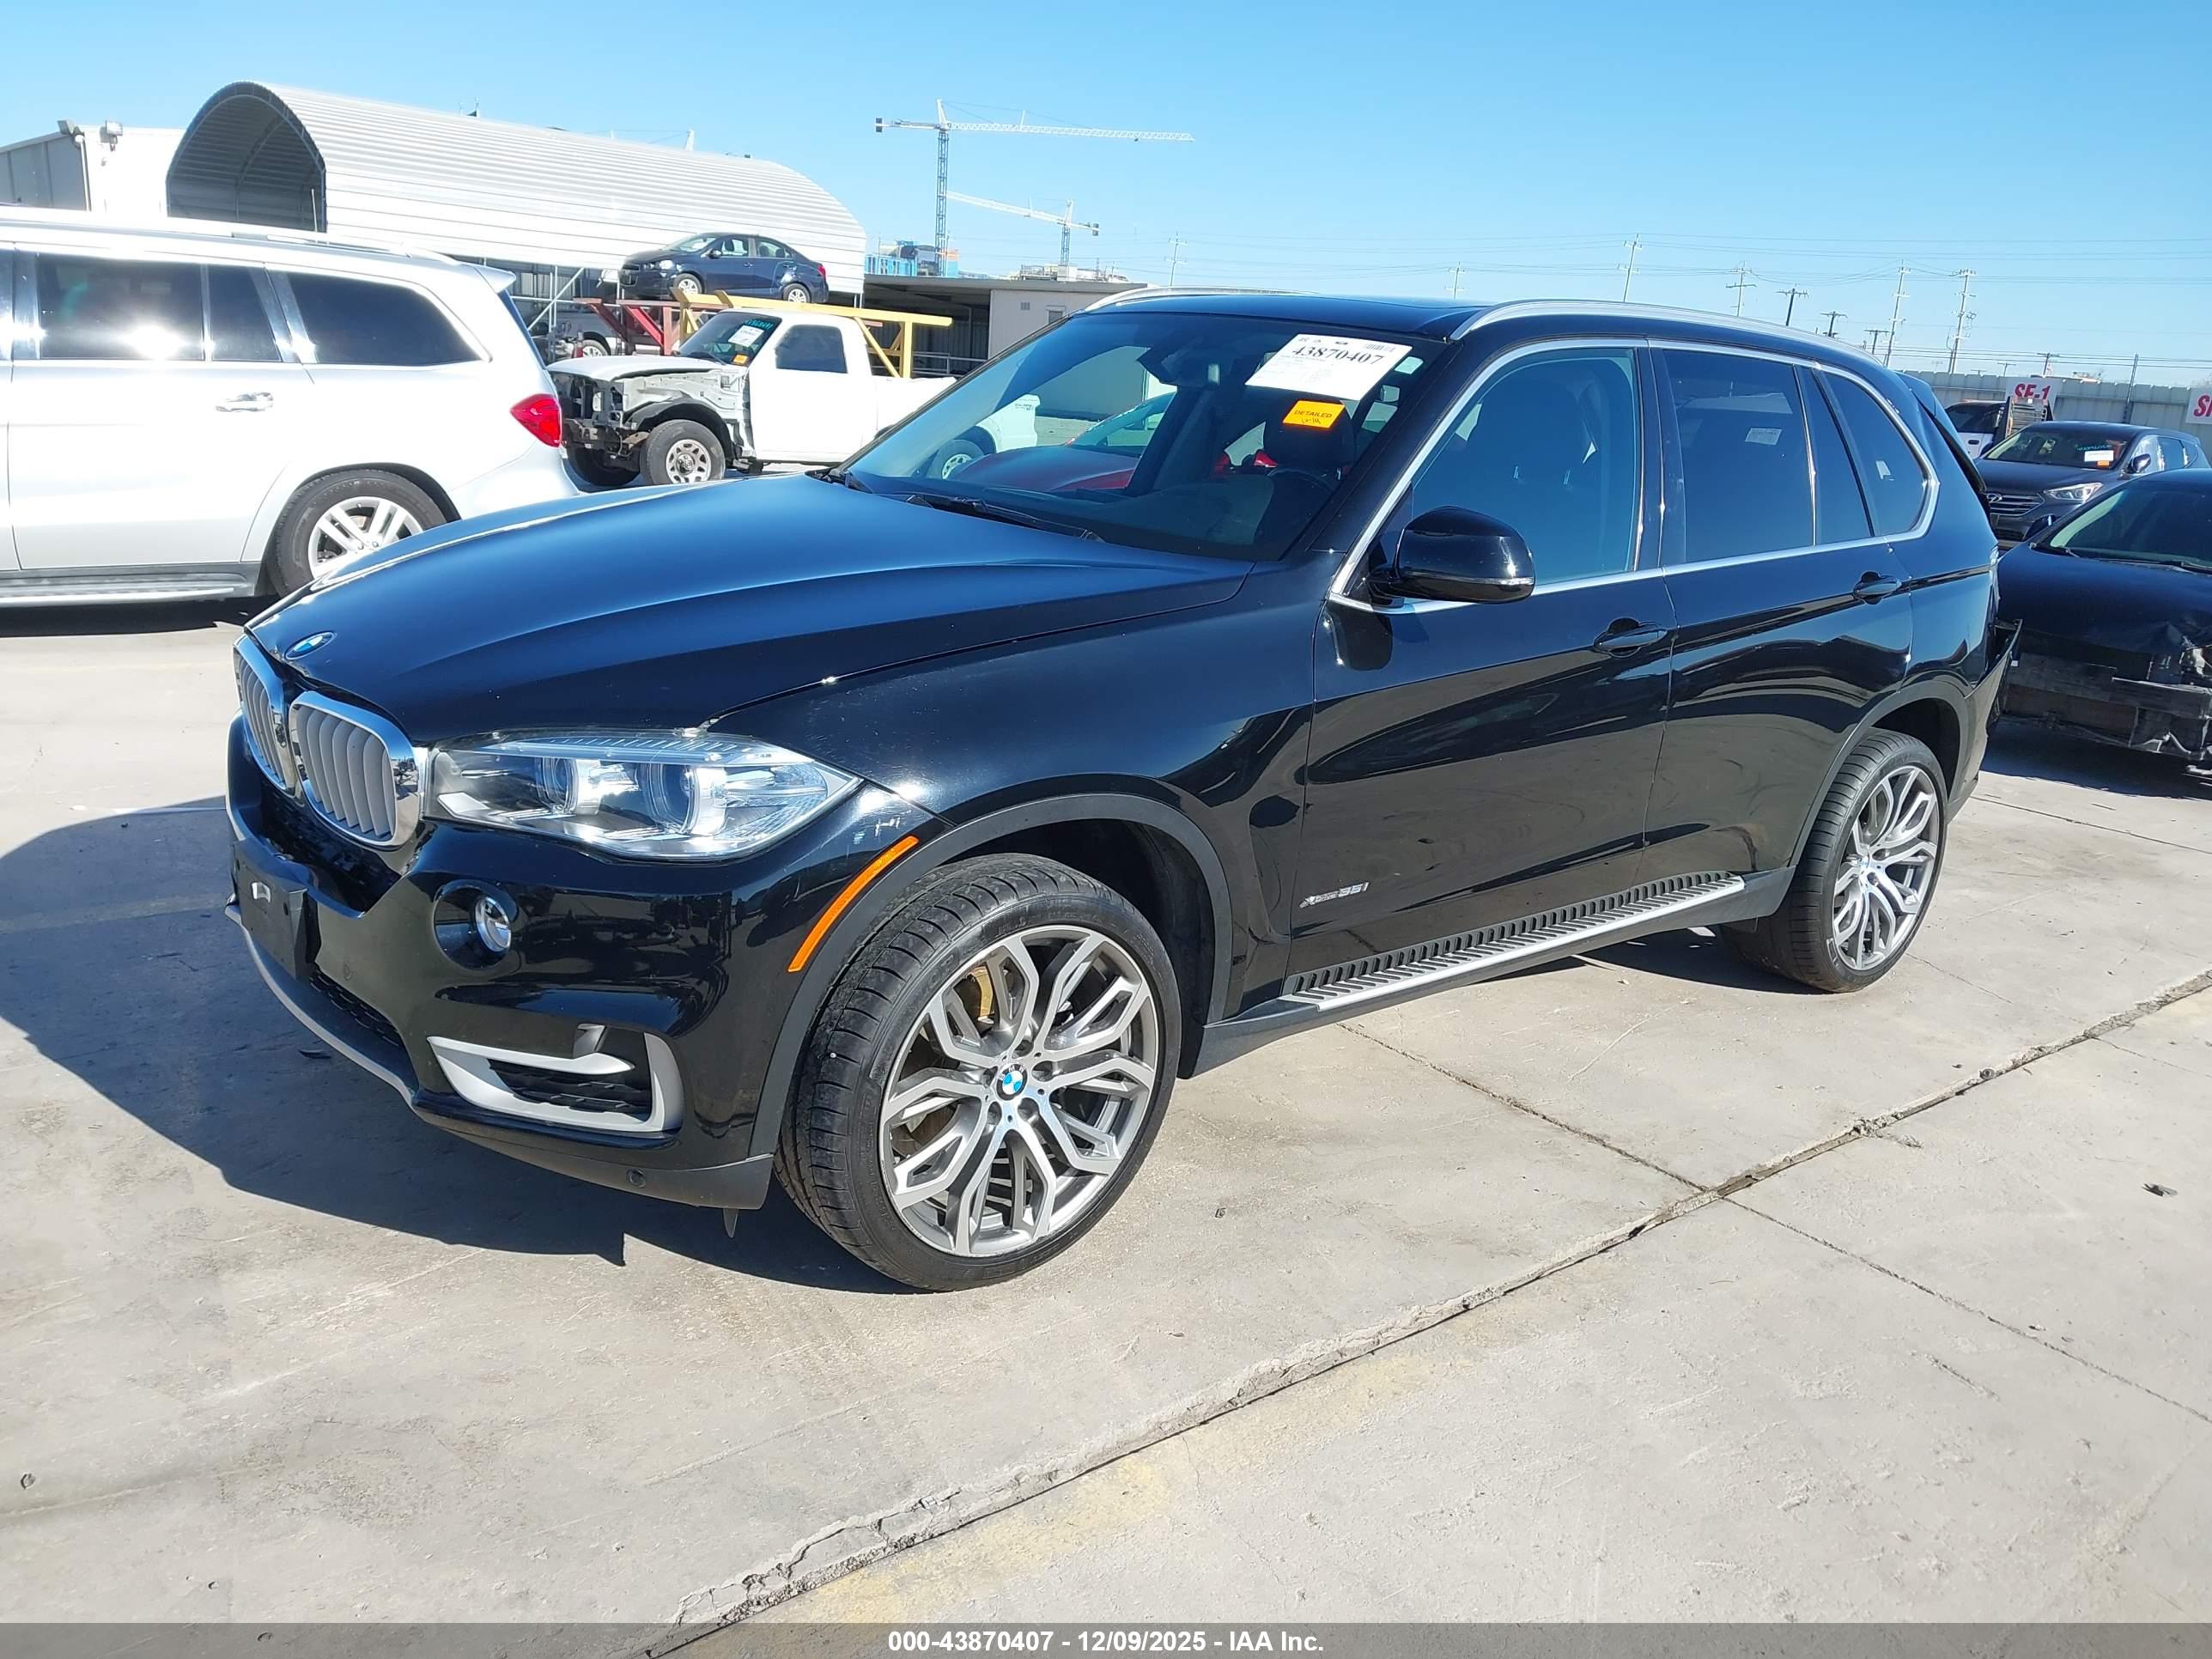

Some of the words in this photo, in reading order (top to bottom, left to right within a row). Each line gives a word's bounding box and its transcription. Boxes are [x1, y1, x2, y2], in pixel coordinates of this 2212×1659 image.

[1292, 345, 1384, 365] 43870407
[1294, 410, 1333, 418] DETAILED
[2193, 394, 2212, 417] S
